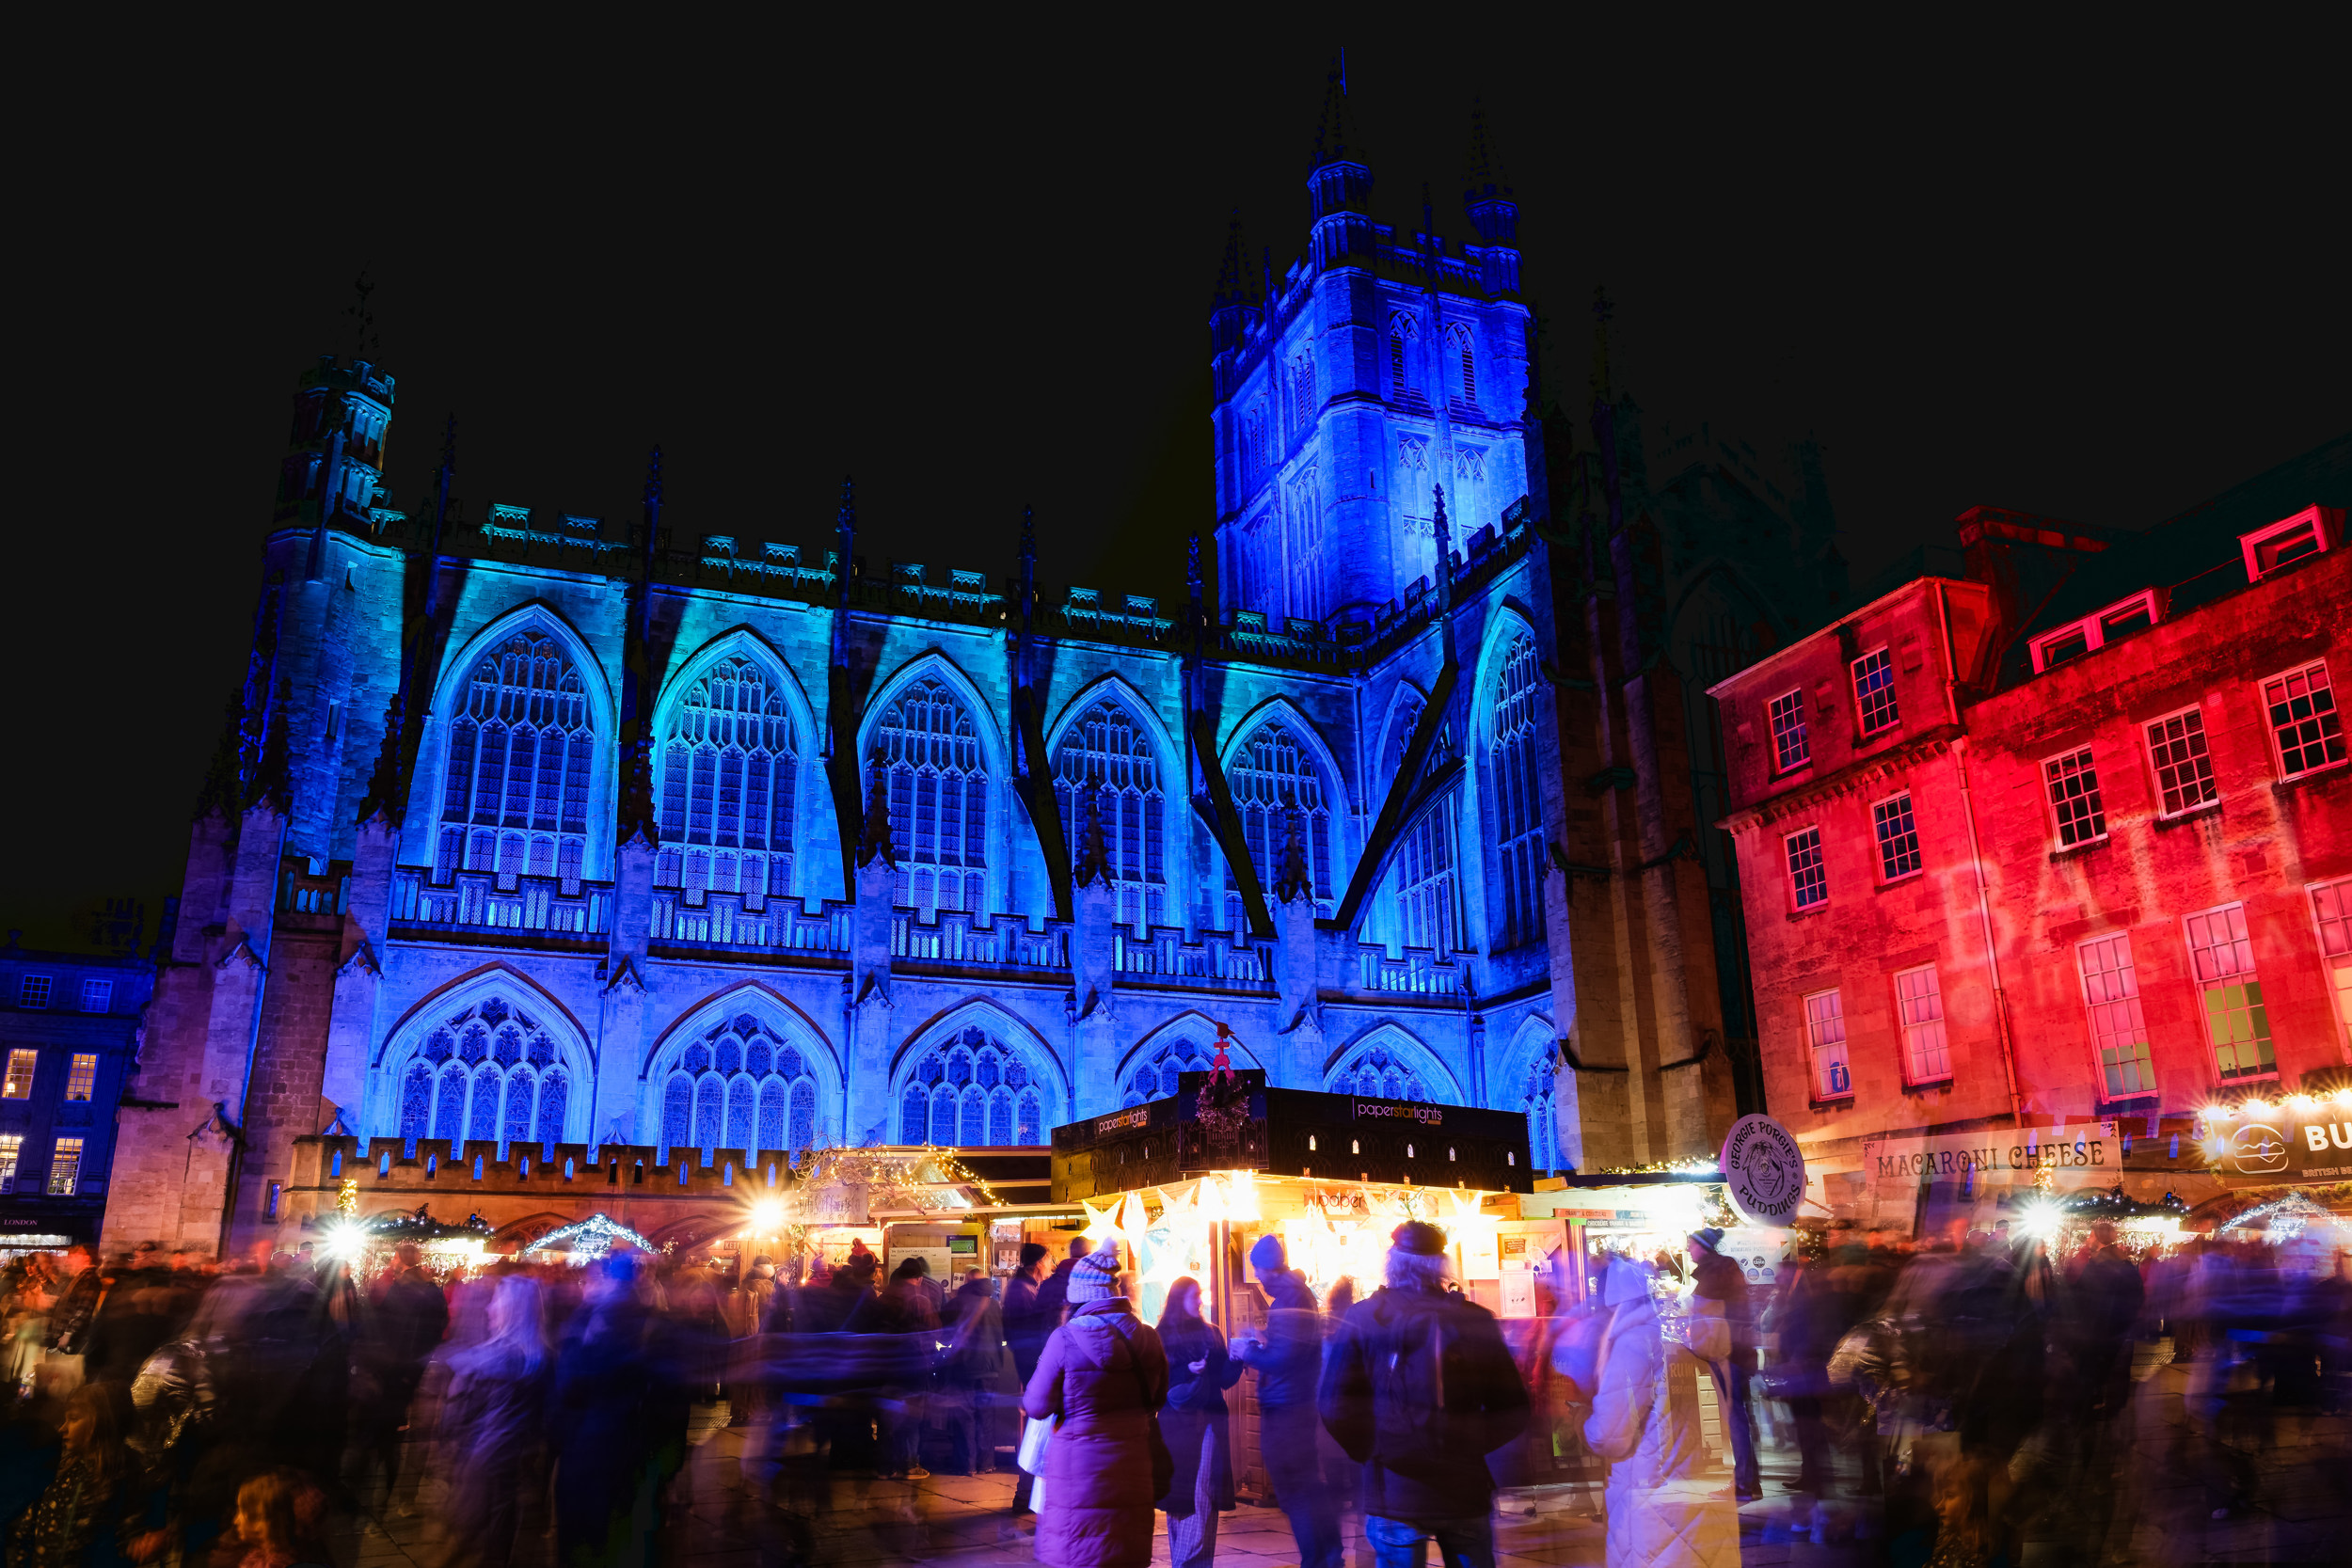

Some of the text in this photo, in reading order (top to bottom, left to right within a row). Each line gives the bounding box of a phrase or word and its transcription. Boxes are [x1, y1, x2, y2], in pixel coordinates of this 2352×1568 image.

[1099, 1108, 1148, 1134] paperstarlights
[1358, 1103, 1443, 1124] paperstarlights
[1731, 1121, 1799, 1170] GEORGIE PORGIE'S
[1876, 1141, 2105, 1178] MACARONI CHEESE
[2302, 1167, 2340, 1177] BRITISH
[1739, 1183, 1802, 1216] PUDDINGS
